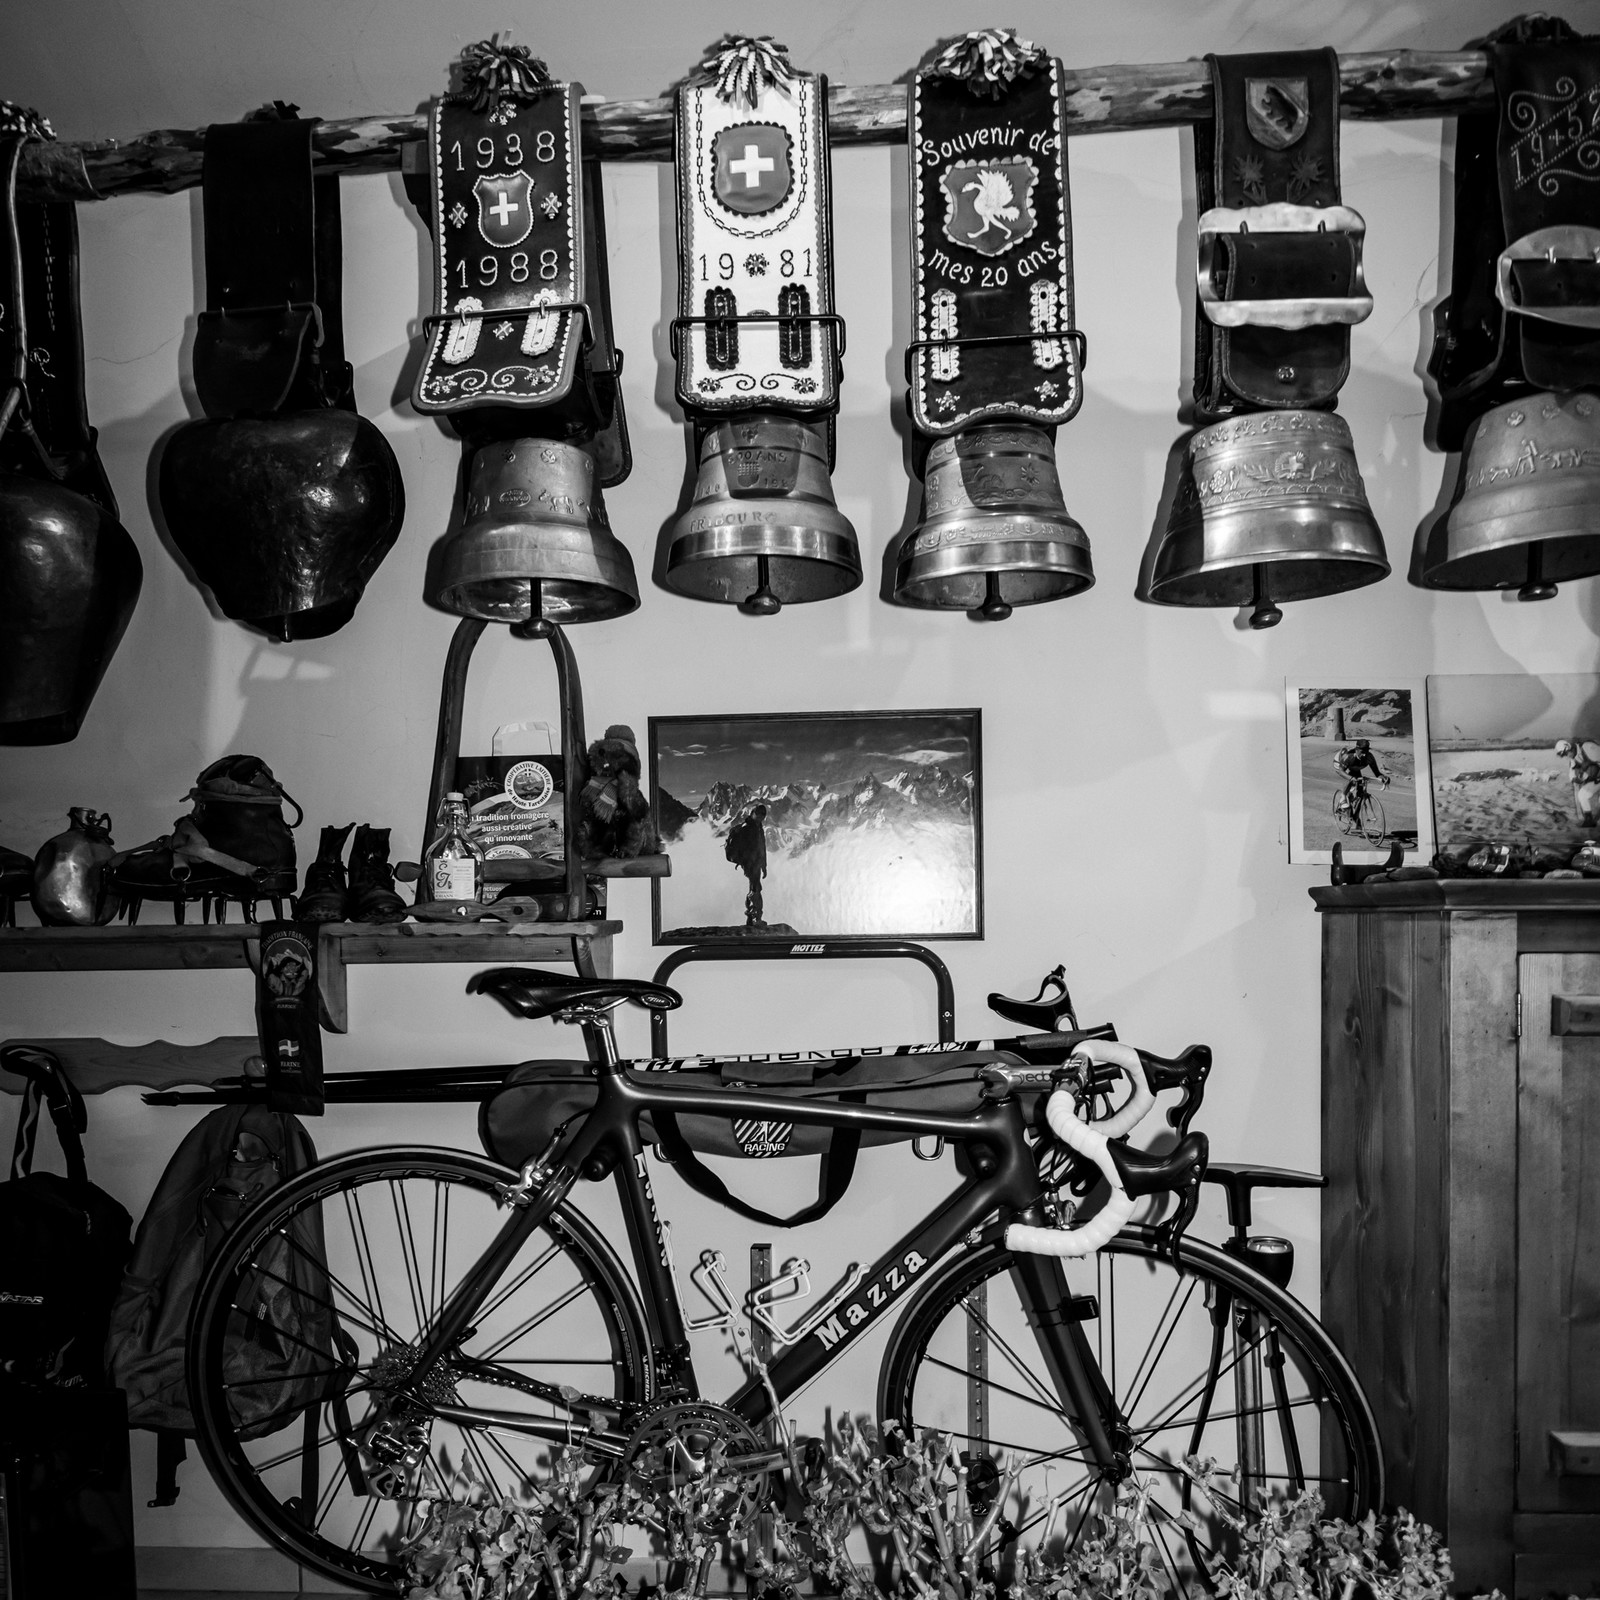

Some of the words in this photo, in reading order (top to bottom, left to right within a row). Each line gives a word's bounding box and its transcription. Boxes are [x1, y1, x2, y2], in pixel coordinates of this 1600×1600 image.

[451, 130, 555, 171] 1938
[922, 126, 1025, 166] Souvenir
[1029, 128, 1056, 155] de
[456, 248, 559, 288] 1988
[699, 252, 734, 281] 19
[779, 247, 813, 278] 81
[928, 247, 973, 284] mes
[981, 267, 1009, 287] 20
[1017, 240, 1057, 278] ans
[475, 812, 509, 822] tradition
[481, 825, 501, 833] aussi
[484, 833, 534, 844] qu'innovante
[791, 944, 826, 952] MOTTEZ
[744, 1142, 786, 1153] RACING
[813, 1250, 928, 1351] Mazza
[643, 1363, 652, 1402] MICHELIN
